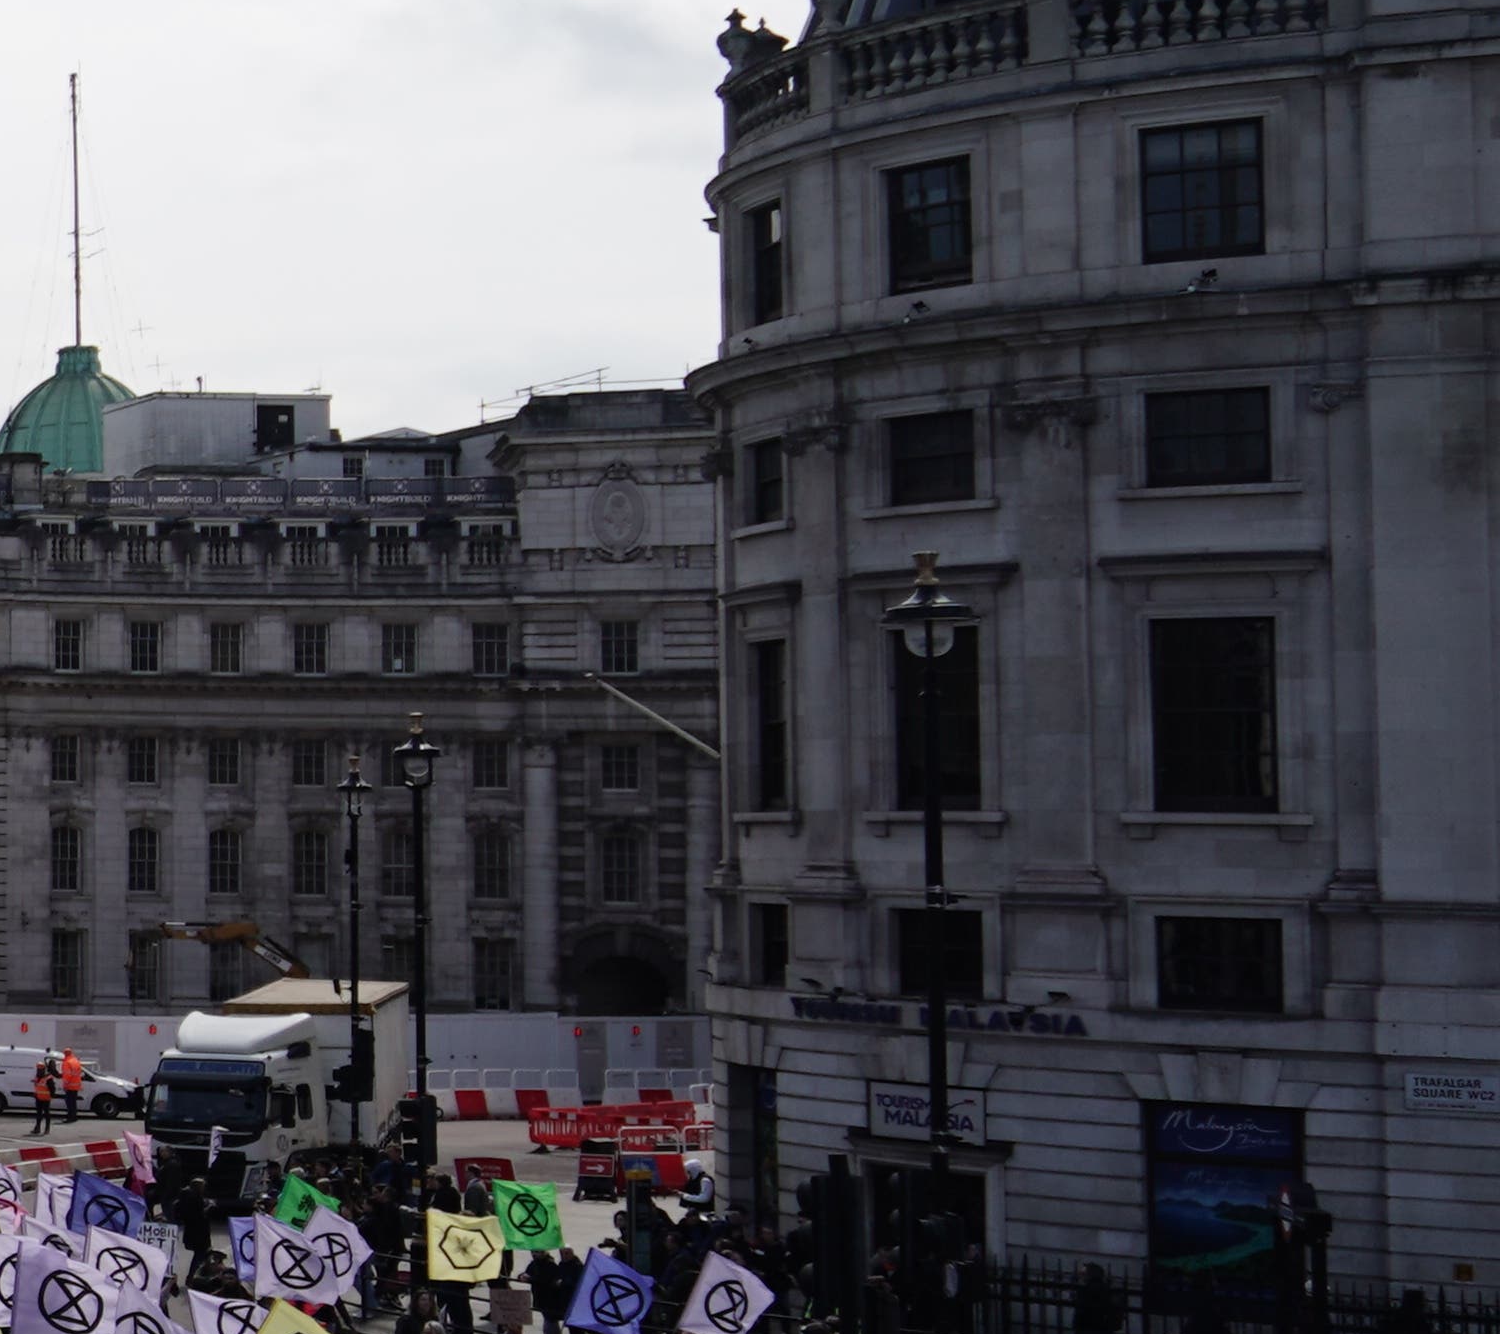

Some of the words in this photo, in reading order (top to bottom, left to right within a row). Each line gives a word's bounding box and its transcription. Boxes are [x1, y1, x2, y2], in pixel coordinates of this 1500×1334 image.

[919, 1002, 1088, 1037] ALASIA
[1413, 1076, 1483, 1090] TRAFALGAR
[875, 1093, 932, 1111] TOURISM
[1413, 1088, 1468, 1101] SQUARE
[1468, 1090, 1496, 1102] WC2
[884, 1108, 975, 1132] MALASIA
